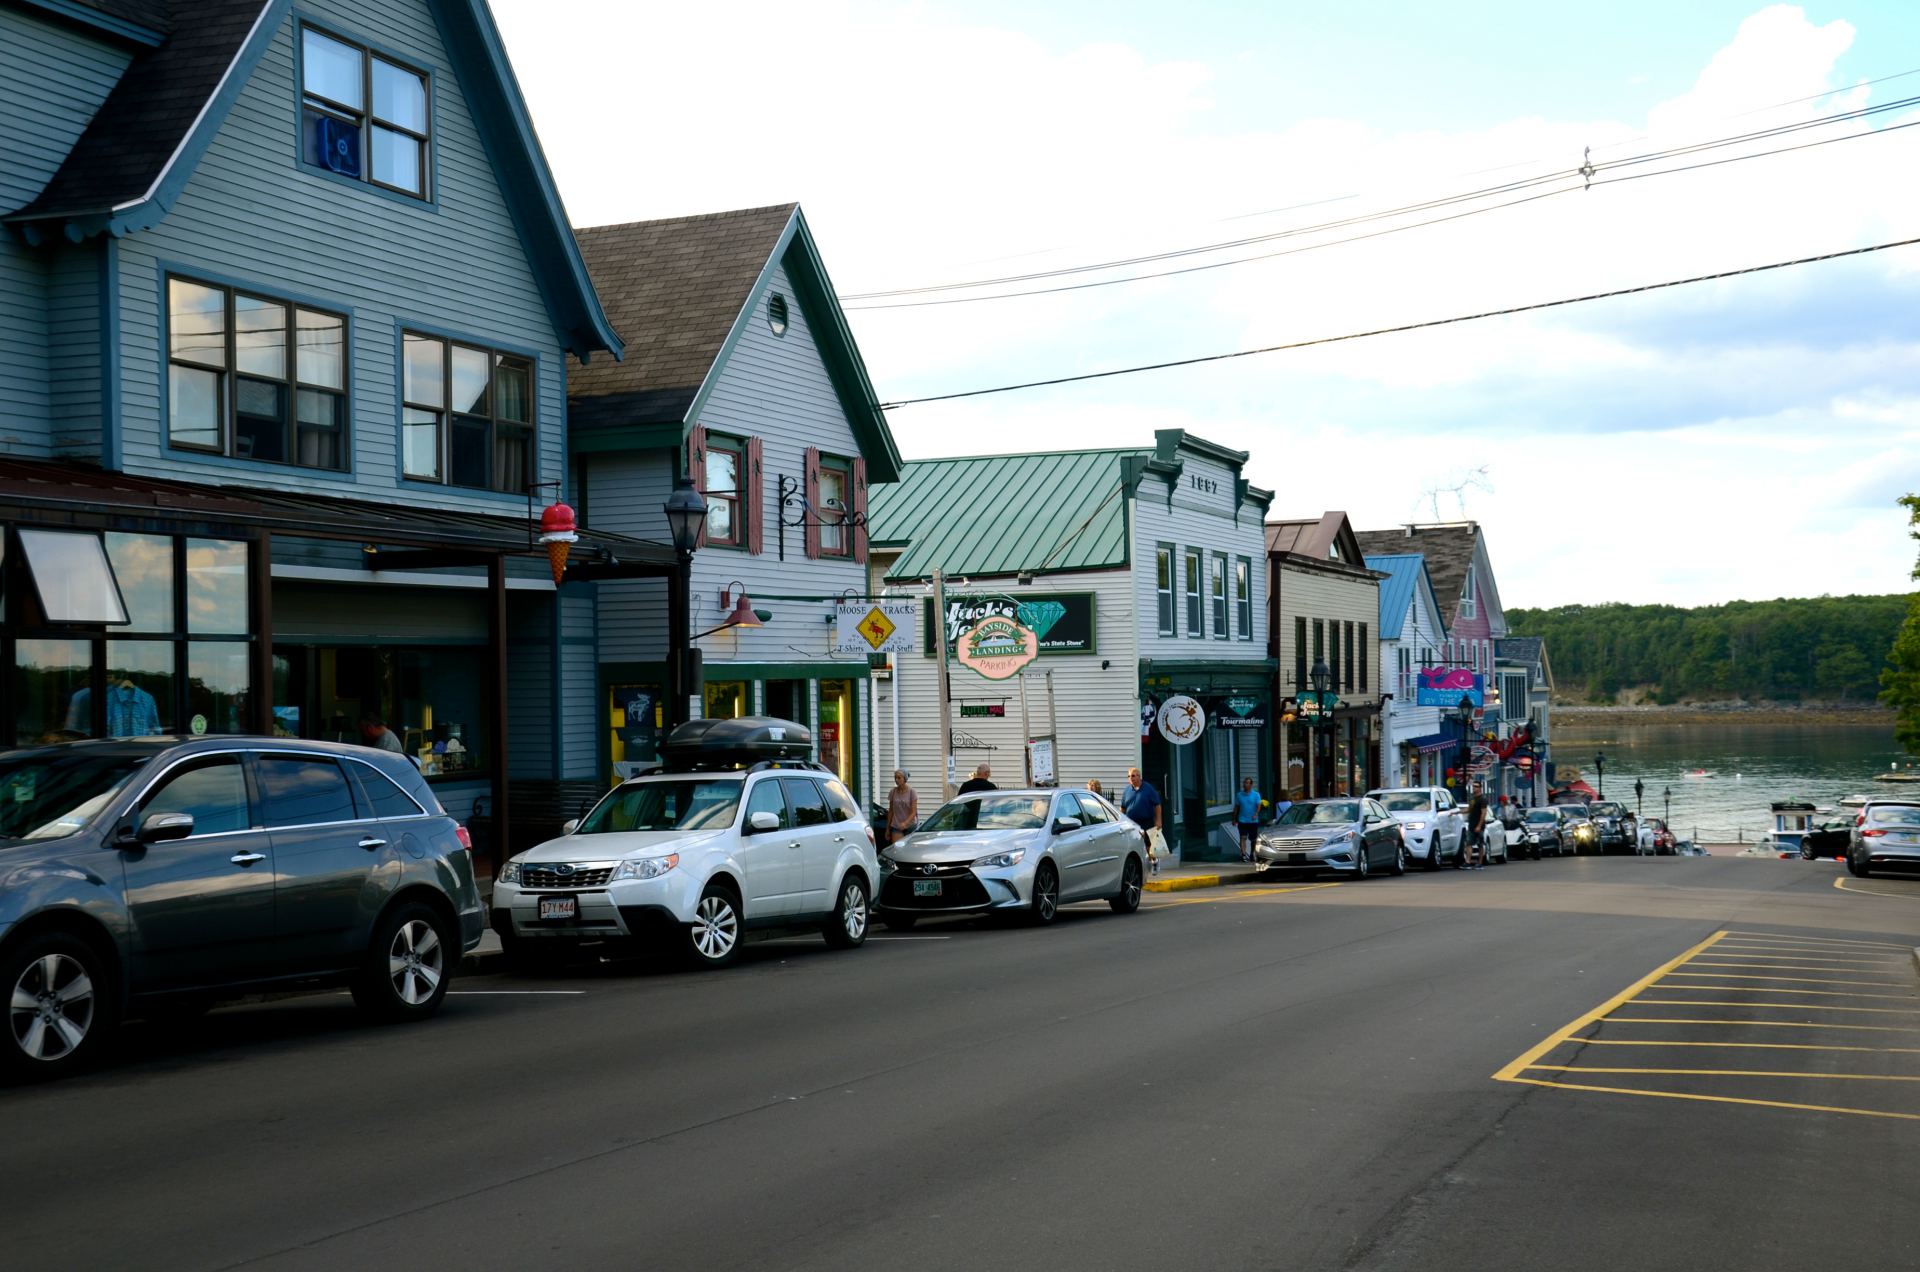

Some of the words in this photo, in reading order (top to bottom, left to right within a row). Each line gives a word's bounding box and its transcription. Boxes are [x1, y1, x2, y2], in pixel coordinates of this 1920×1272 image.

[839, 606, 867, 615] MOOSE
[883, 606, 915, 615] TRACKS
[945, 602, 1014, 623] Jack's
[979, 622, 1014, 637] BAYSIDE
[883, 644, 895, 652] and
[896, 644, 913, 652] Stuff
[976, 646, 1018, 656] LANDING
[980, 657, 1016, 671] PARKING
[1220, 716, 1265, 726] Tourmaline
